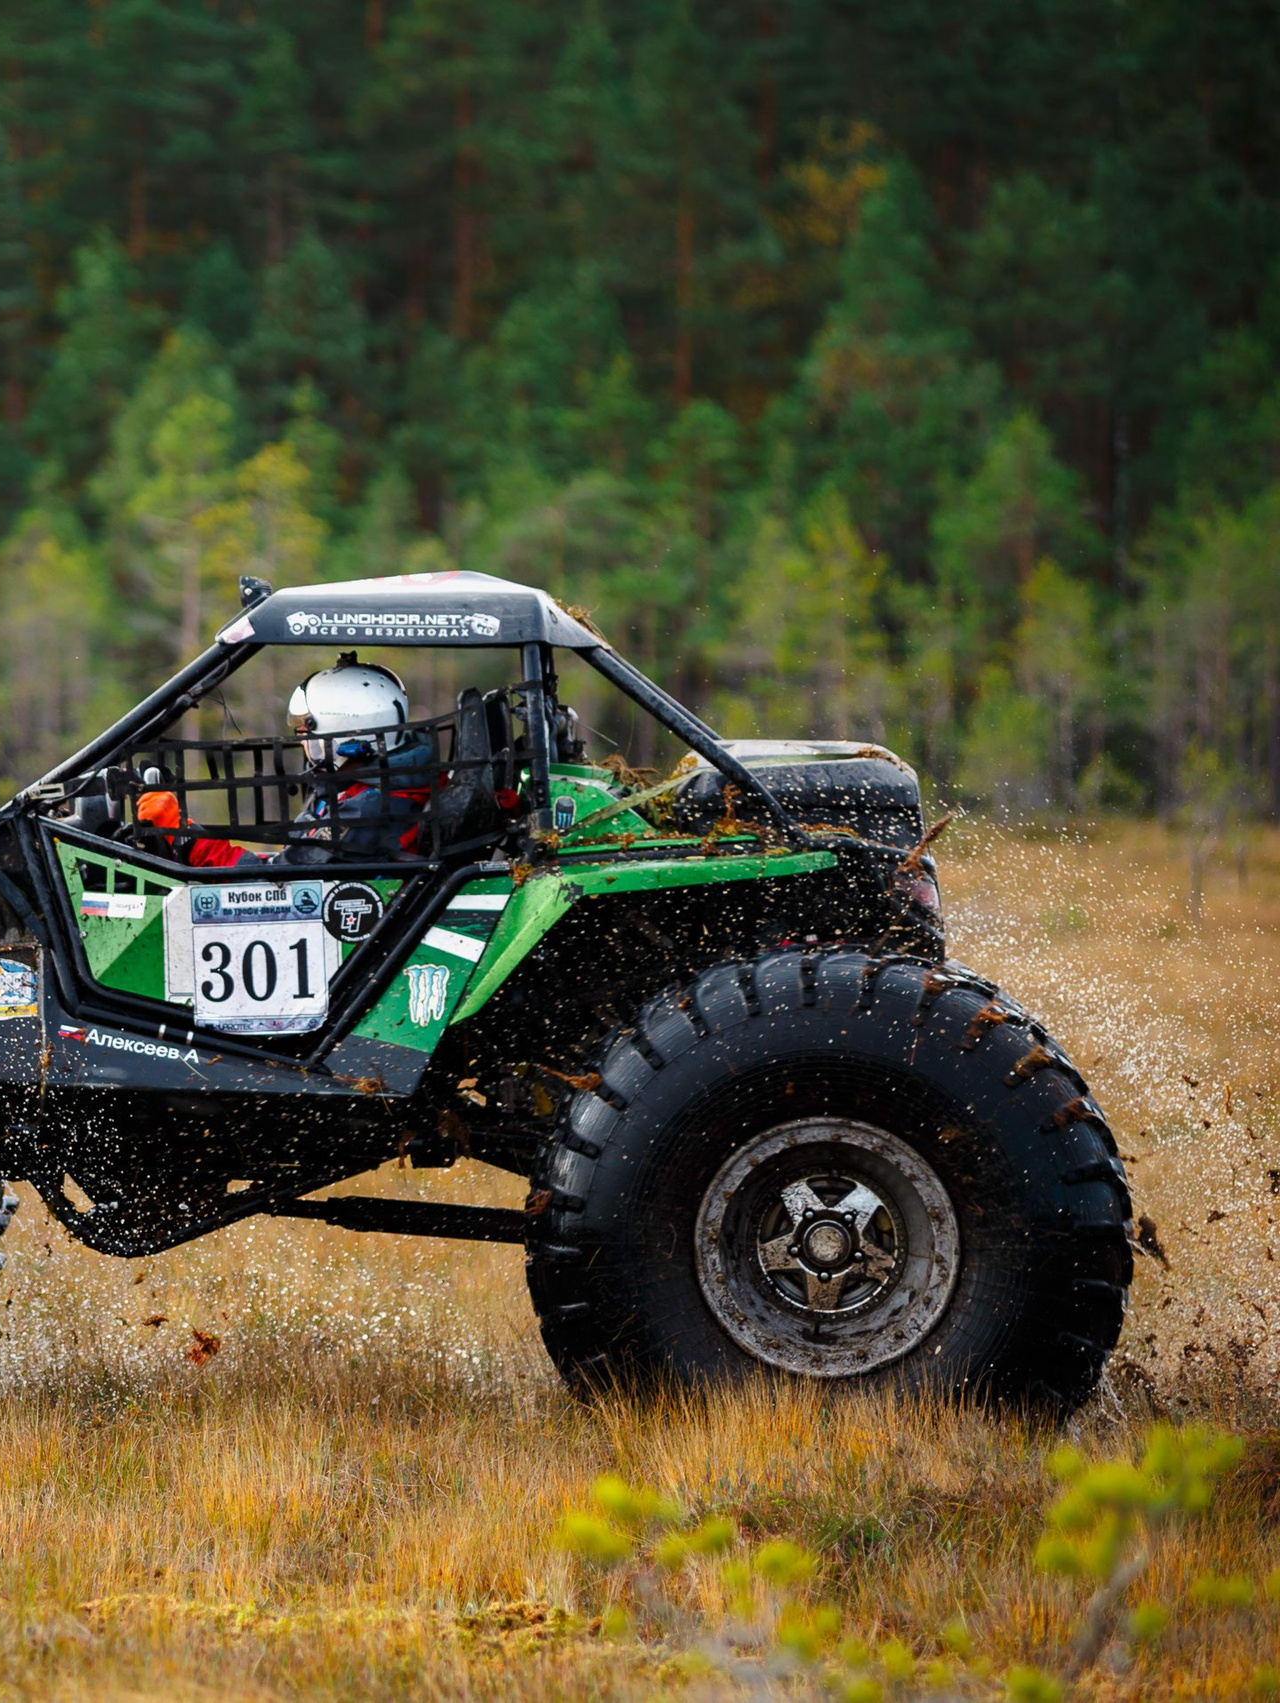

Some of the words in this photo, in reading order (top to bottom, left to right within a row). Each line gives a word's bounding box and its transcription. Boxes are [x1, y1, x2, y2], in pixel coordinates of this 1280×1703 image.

[365, 627, 469, 638] ВЕЗДЕХОДАХ
[228, 891, 262, 904] Кубок
[265, 890, 287, 901] СПб
[201, 938, 315, 1002] 301
[86, 1028, 179, 1060] Алексеев
[183, 1048, 200, 1064] А
